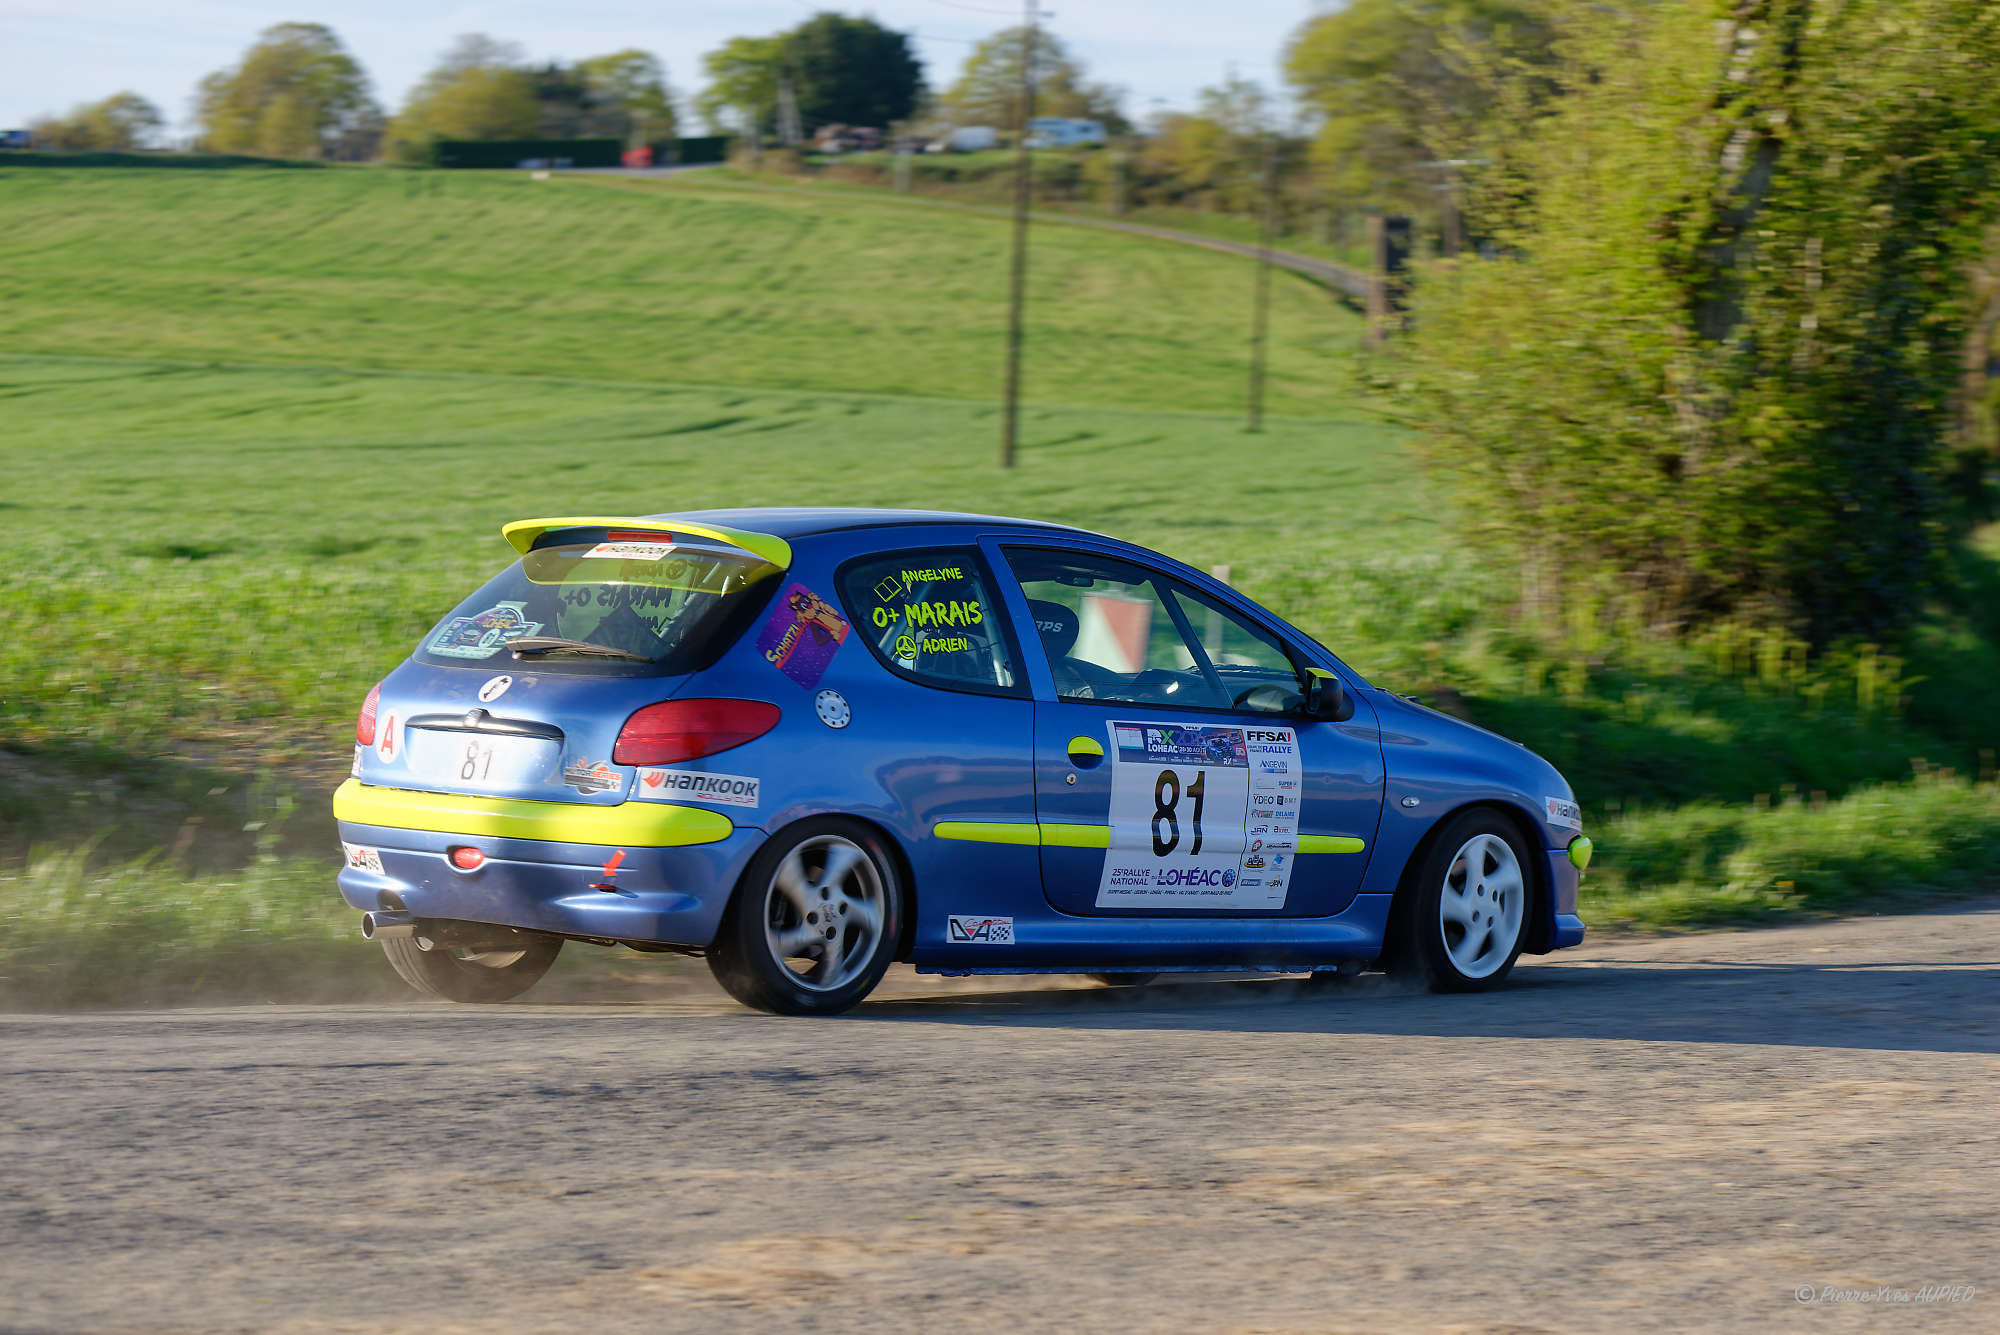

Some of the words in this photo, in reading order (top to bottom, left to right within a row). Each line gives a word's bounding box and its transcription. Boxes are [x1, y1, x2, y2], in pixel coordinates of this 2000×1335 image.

[901, 568, 964, 584] ANGELYNE
[904, 601, 983, 628] MARAIS
[765, 623, 799, 662] SCHATZI
[922, 638, 968, 654] ADRIEN
[380, 715, 395, 755] A
[461, 740, 494, 780] 81
[1262, 745, 1292, 754] RALLYE
[1151, 769, 1206, 857] 81
[1110, 877, 1149, 886] NATIONAL
[1157, 867, 1222, 886] LOHÉAC
